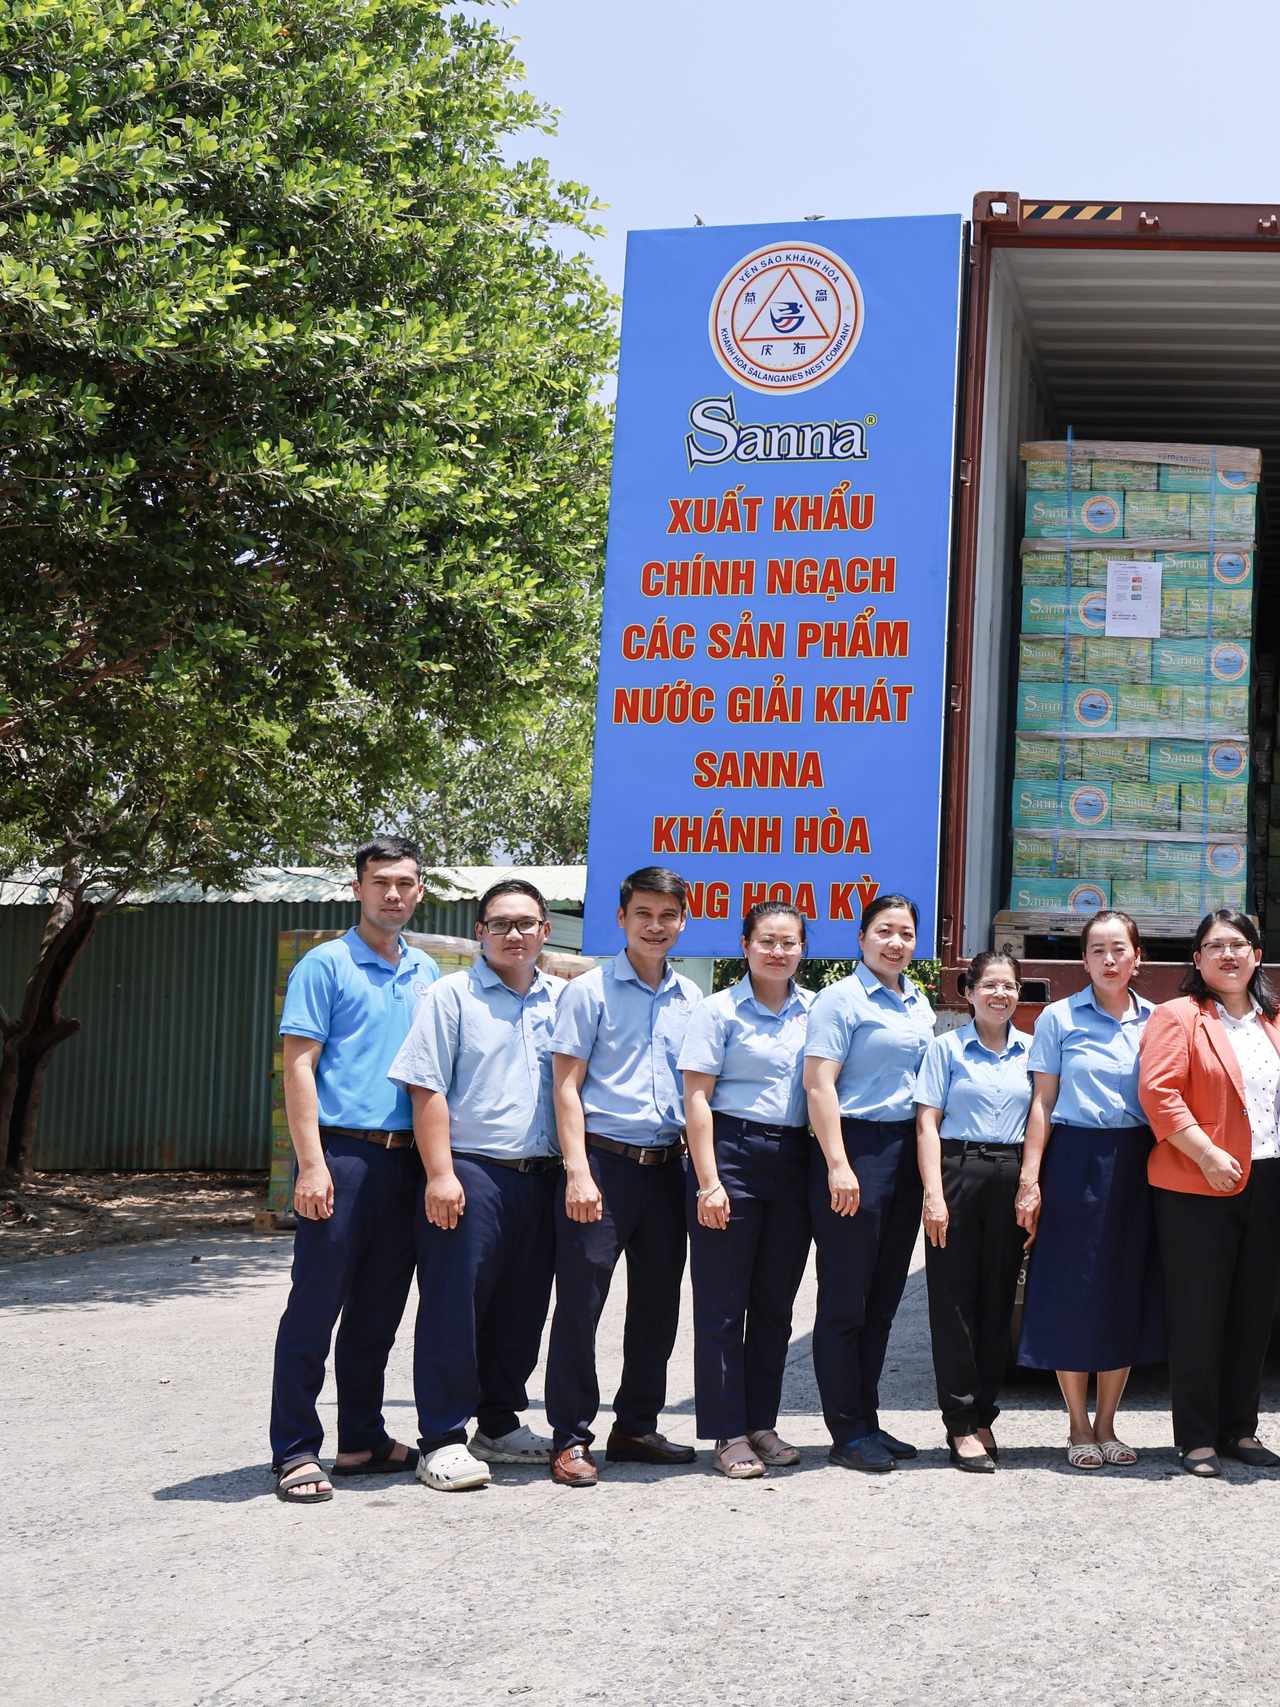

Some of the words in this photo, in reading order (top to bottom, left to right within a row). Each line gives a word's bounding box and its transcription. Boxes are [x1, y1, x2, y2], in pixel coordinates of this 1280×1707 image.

[786, 253, 821, 268] KHÁNH
[720, 327, 735, 357] KHANH
[732, 354, 747, 371] HOA
[747, 367, 804, 383] SALANGANES
[805, 360, 826, 377] NEST
[825, 323, 851, 362] COMPANY
[686, 392, 869, 473] Sanna
[666, 489, 764, 535] XUẤT
[773, 480, 875, 532] KHẨU
[640, 559, 756, 598] CHÍNH
[766, 556, 896, 603] NGẠCH
[1164, 553, 1208, 569] Sanna
[621, 623, 696, 661] CÁC
[706, 610, 786, 660] SẢN
[796, 606, 910, 659] PHẨM
[1023, 644, 1056, 658] Sanna
[1089, 646, 1123, 659] Sanna
[1161, 649, 1204, 666] Sanna
[612, 683, 715, 725] NƯỚC
[726, 673, 803, 724] GIẢI
[814, 677, 914, 723] KHÁT
[693, 750, 824, 789] SANNA
[1159, 746, 1203, 764] Sanna
[652, 808, 783, 854] KHÁNH
[793, 807, 871, 855] HÒA
[1017, 840, 1052, 853] Sanna
[685, 881, 731, 919] NG
[741, 881, 818, 920] HOA
[828, 874, 880, 921] KỲ
[1018, 890, 1062, 908] Sanna
